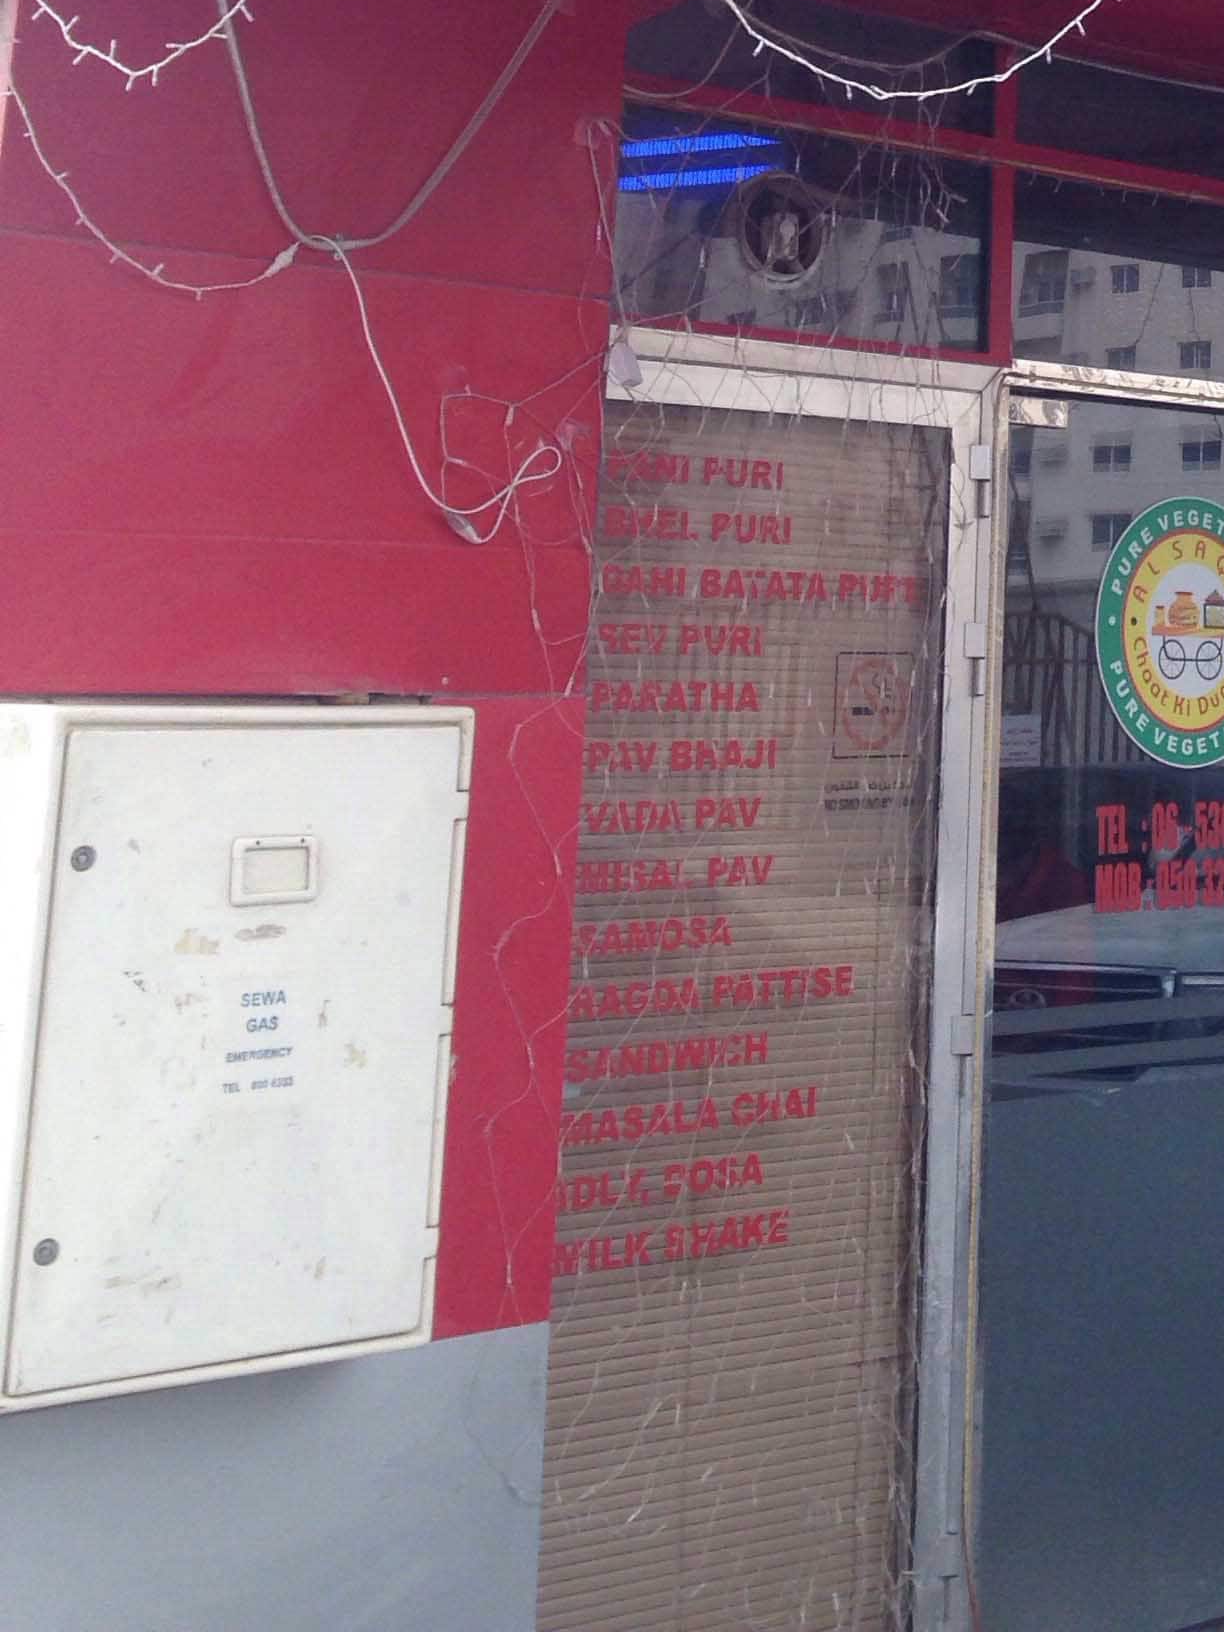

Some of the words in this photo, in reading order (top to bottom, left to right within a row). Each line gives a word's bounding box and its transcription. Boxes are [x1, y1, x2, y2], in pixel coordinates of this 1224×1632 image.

[703, 455, 785, 490] PURI
[711, 512, 793, 545] PURI
[1111, 527, 1153, 595] PURE
[702, 568, 828, 602] BATATA
[1133, 561, 1161, 604] AL
[599, 624, 669, 655] SEV
[680, 624, 764, 656] PURI
[592, 680, 761, 713] PARATHA
[1110, 659, 1149, 732] PURE
[588, 741, 657, 772] PAV
[671, 737, 778, 772] BHAJI
[584, 799, 684, 833] VADA
[696, 795, 764, 831] PAV
[1095, 803, 1129, 856] TEL
[707, 854, 775, 887] PAV
[1094, 861, 1143, 913] MOB
[578, 915, 735, 956] SAMOSA
[240, 990, 287, 1008] SEWA
[713, 966, 855, 1008] PATTISE
[246, 1016, 279, 1033] GAS
[225, 1046, 294, 1063] EMERGENCY
[565, 1031, 769, 1084] SANDWICH
[222, 1081, 241, 1094] TEL
[560, 1096, 720, 1146] MASALA
[732, 1086, 817, 1128] CHAI
[663, 1152, 764, 1198] DOSA
[664, 1209, 790, 1261] SHAKE
